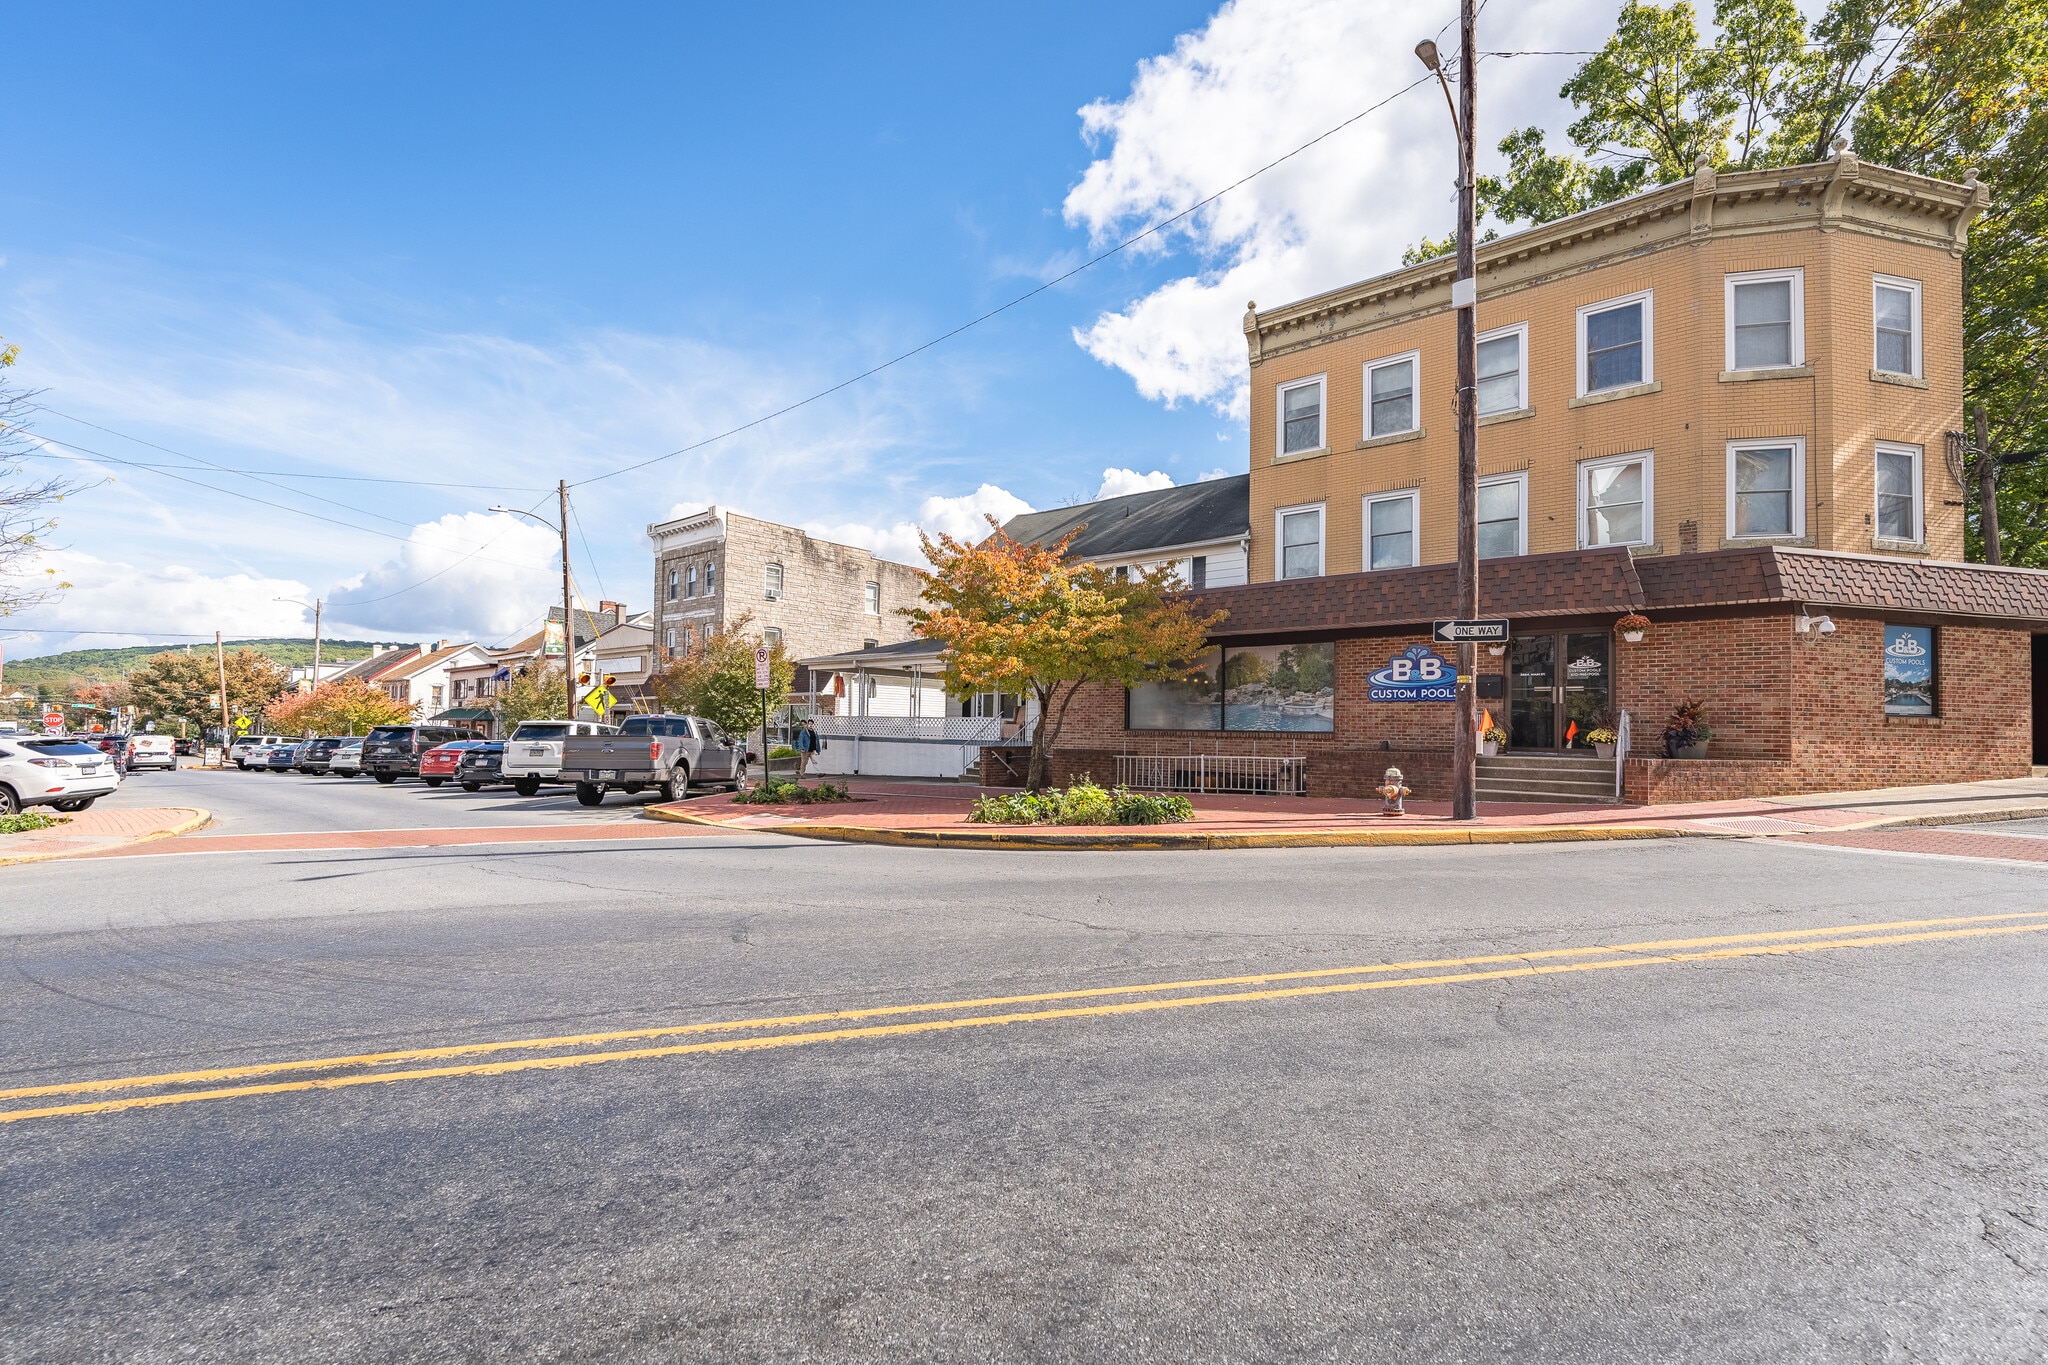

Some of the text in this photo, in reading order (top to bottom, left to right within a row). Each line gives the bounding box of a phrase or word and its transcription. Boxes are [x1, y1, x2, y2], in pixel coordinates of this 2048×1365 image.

[1455, 626, 1499, 635] ONE WAY
[1896, 639, 1917, 653] B&B
[1393, 659, 1442, 681] B&B
[1371, 689, 1416, 698] CUSTOM
